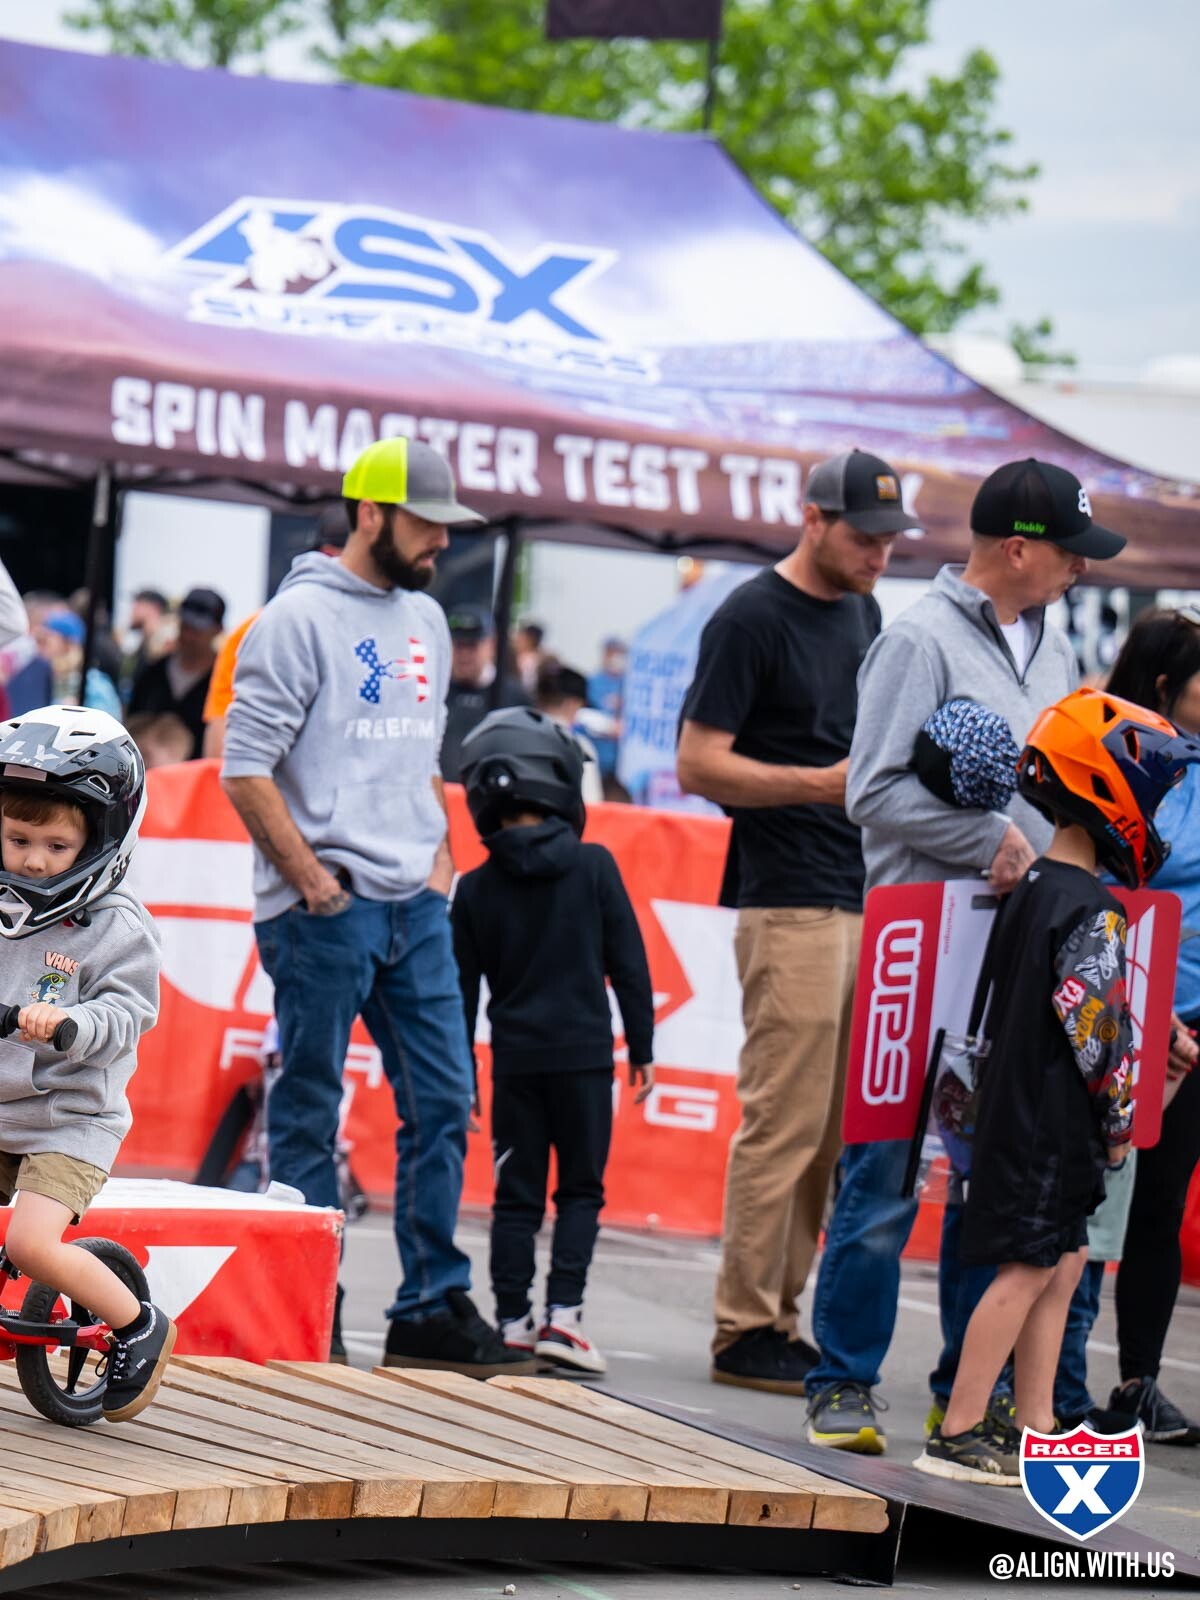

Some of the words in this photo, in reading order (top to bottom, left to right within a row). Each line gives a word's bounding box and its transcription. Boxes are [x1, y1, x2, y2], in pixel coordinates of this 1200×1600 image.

[111, 376, 267, 463] SPIN
[553, 433, 709, 515] TEST
[720, 452, 926, 541] TRK
[44, 951, 81, 977] VANS
[861, 918, 924, 1106] WPS
